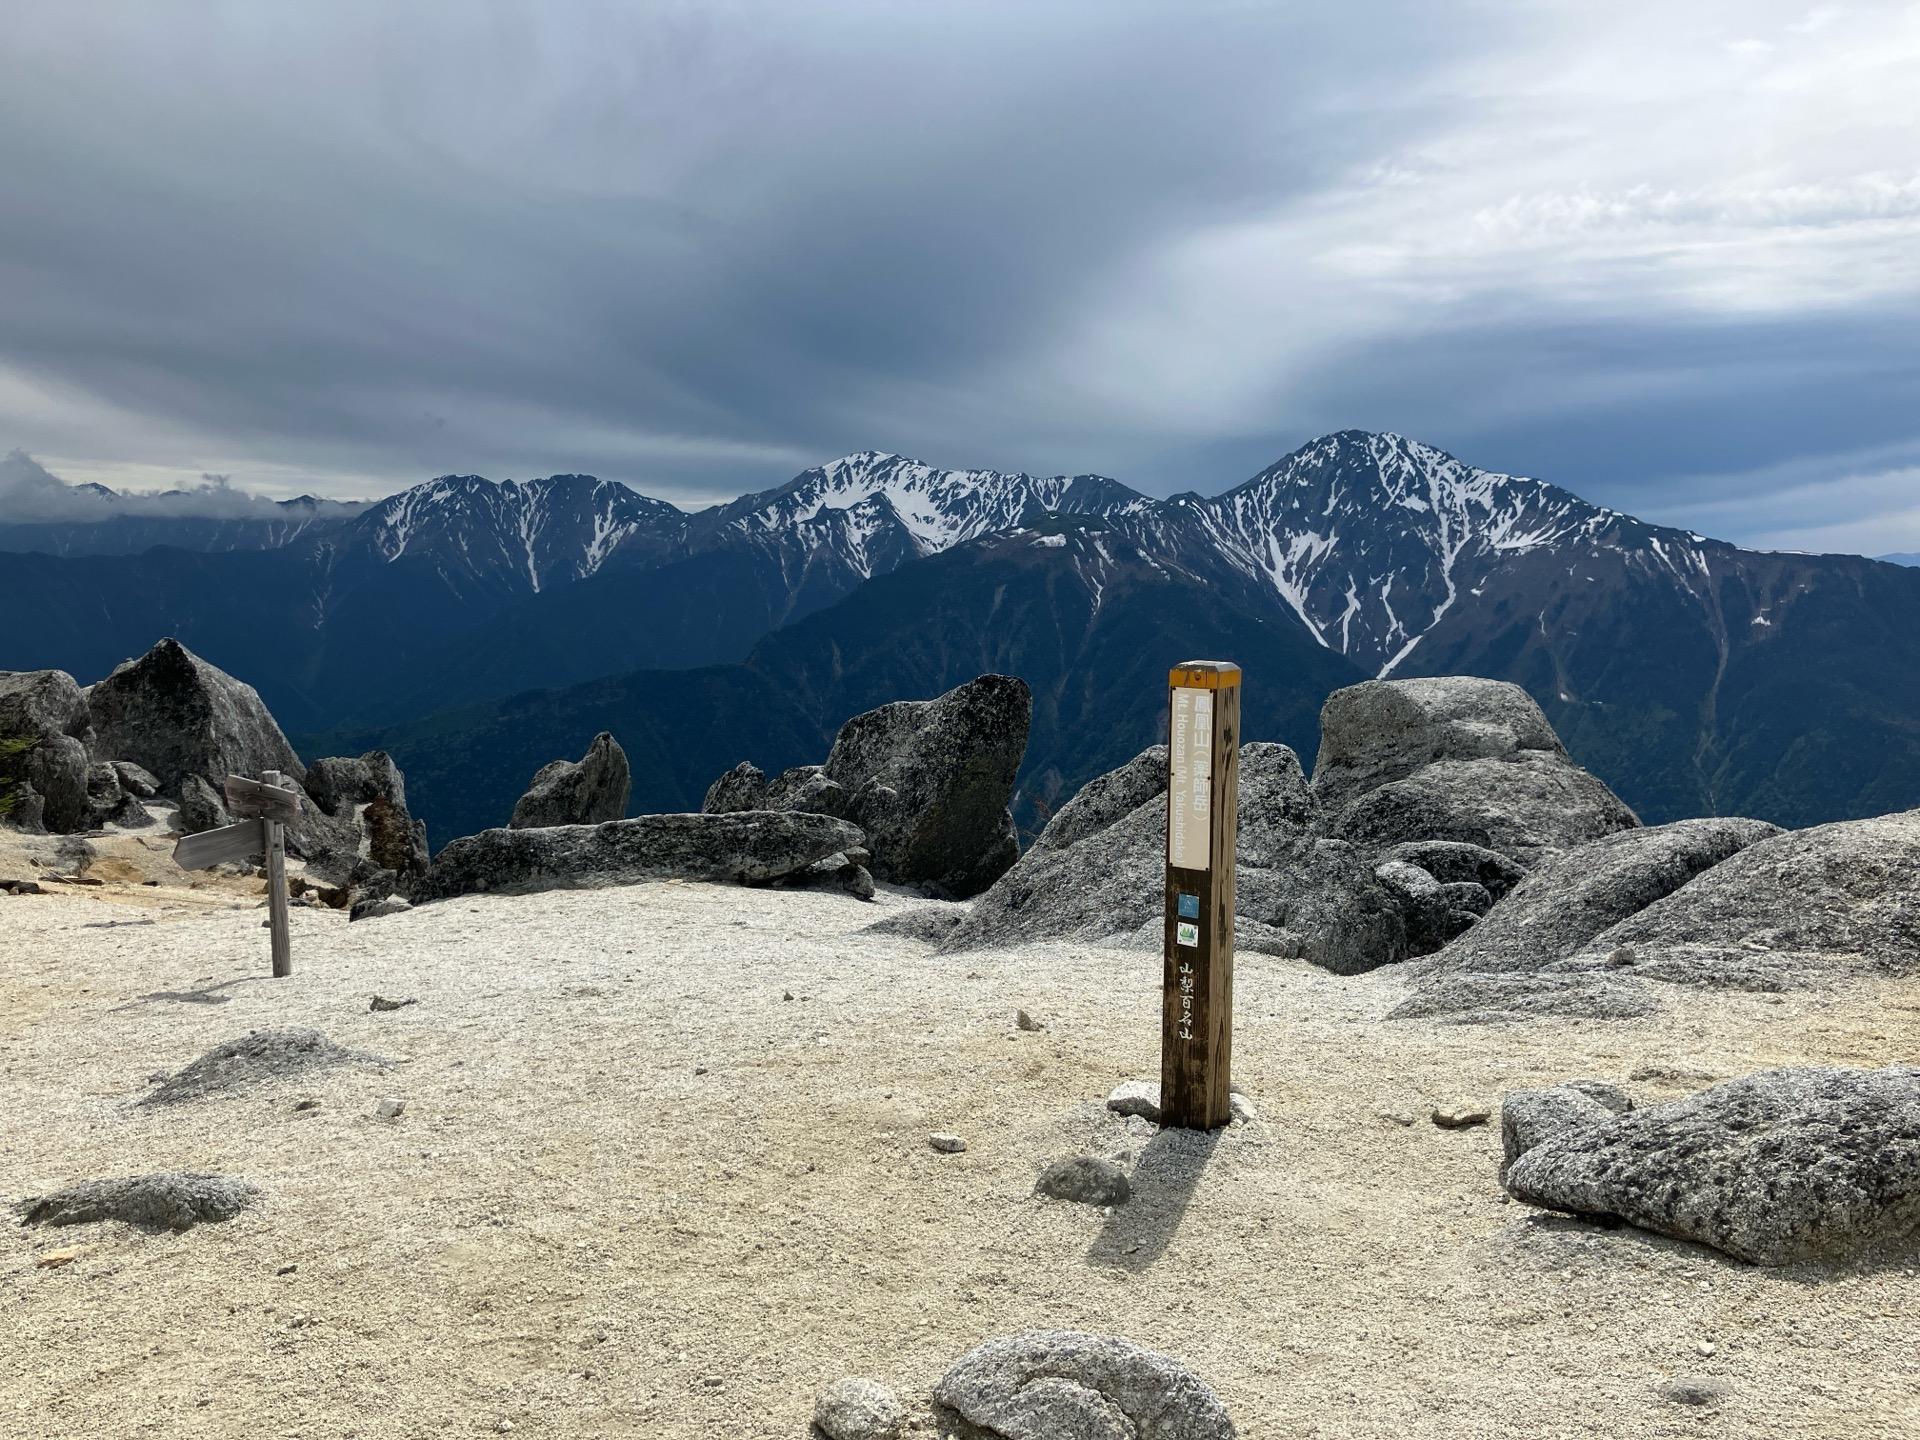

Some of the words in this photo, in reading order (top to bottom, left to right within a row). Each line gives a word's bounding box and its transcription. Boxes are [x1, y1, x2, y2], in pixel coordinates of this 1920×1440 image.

[1176, 693, 1190, 711] Mt.
[1176, 714, 1189, 763] Houozan
[1175, 790, 1187, 863] Yakushidake)
[1178, 962, 1194, 1040] 山梨百名山
